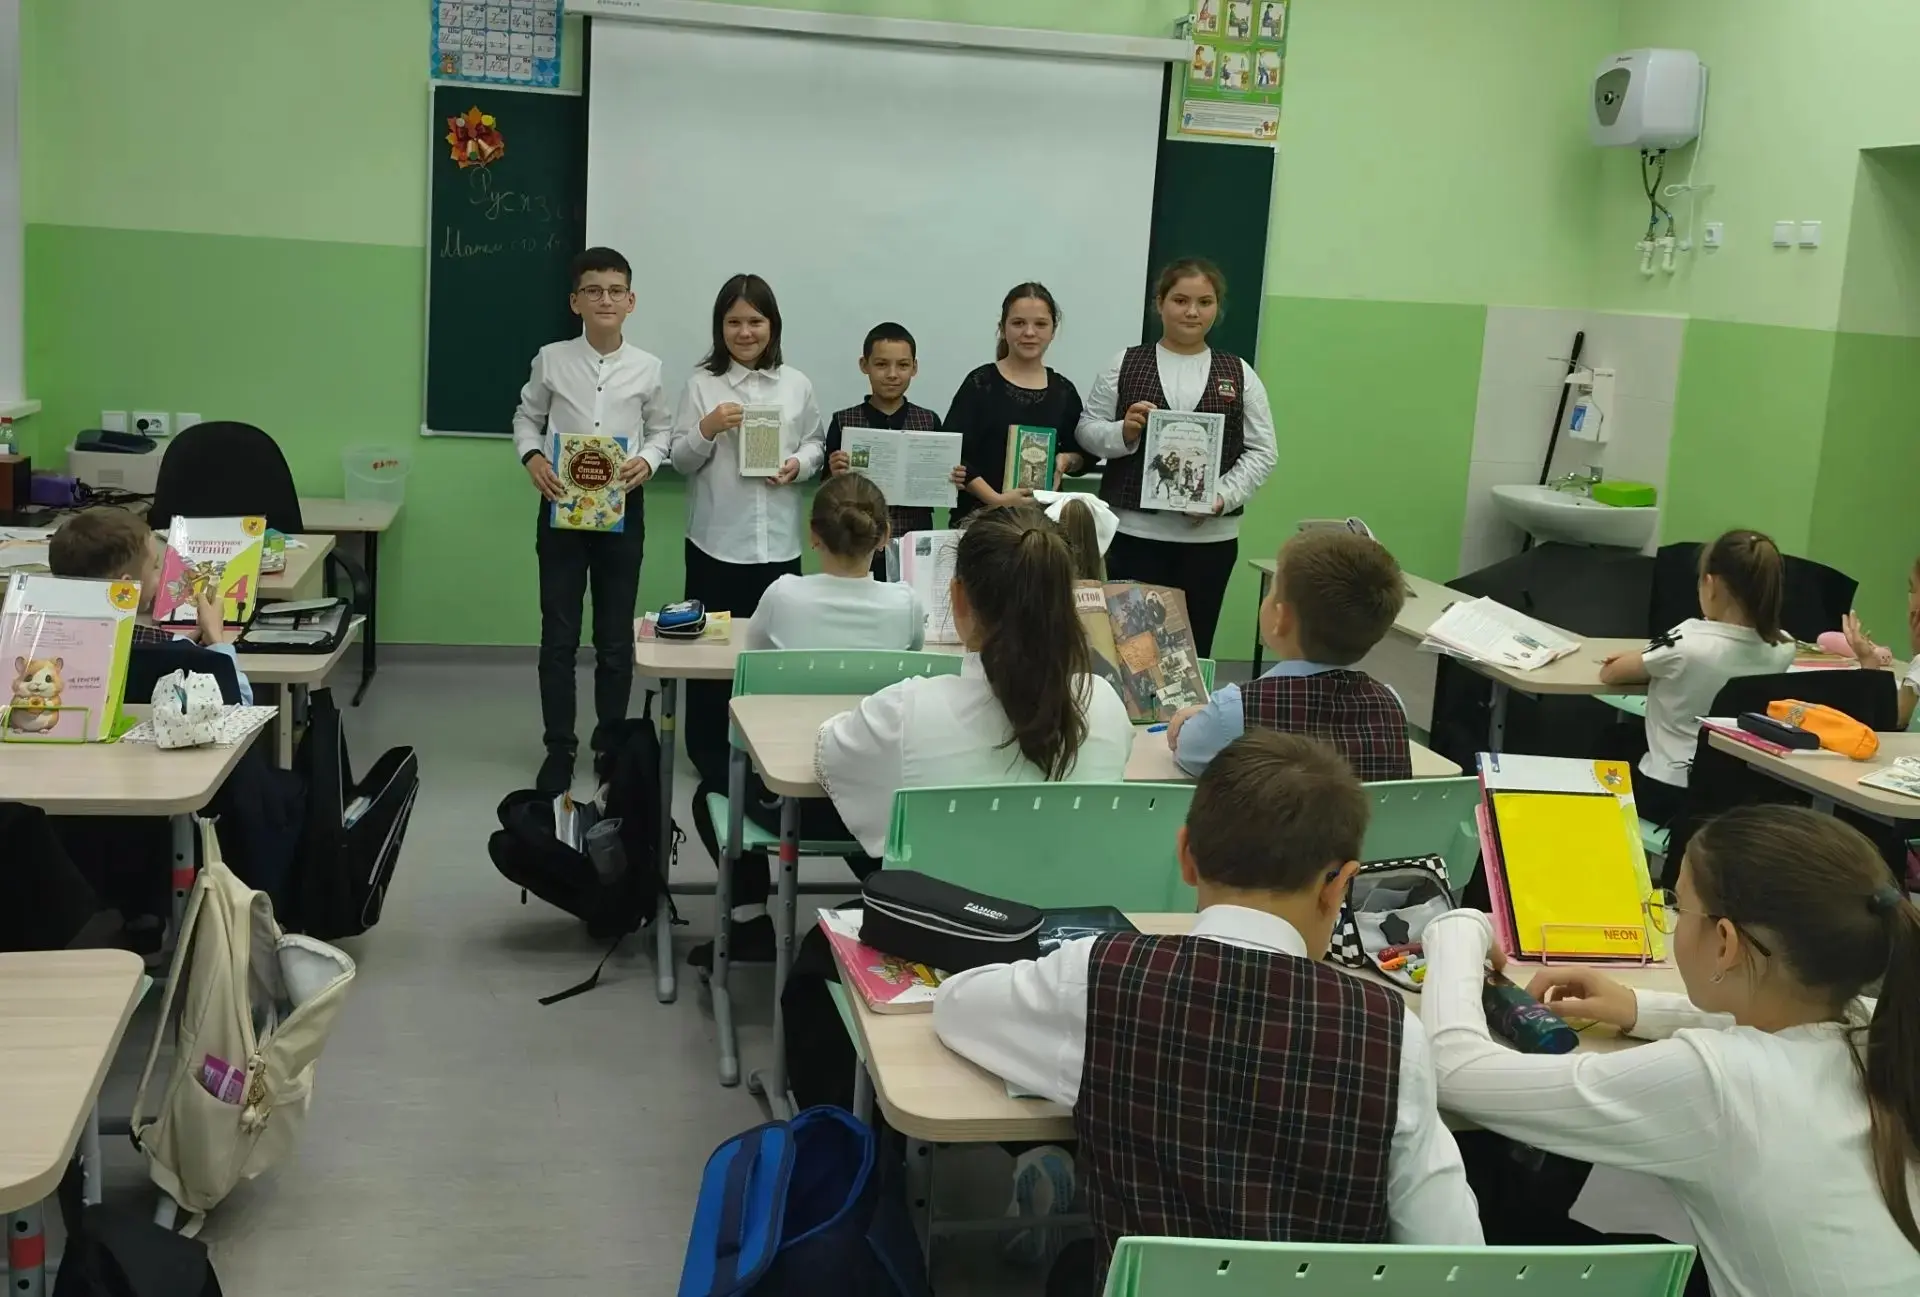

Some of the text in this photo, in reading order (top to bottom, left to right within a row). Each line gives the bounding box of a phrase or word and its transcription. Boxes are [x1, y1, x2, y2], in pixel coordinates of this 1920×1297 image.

[188, 546, 232, 554] ЧТЕНИЕ
[224, 574, 249, 604] 4
[1603, 929, 1638, 941] NEON
